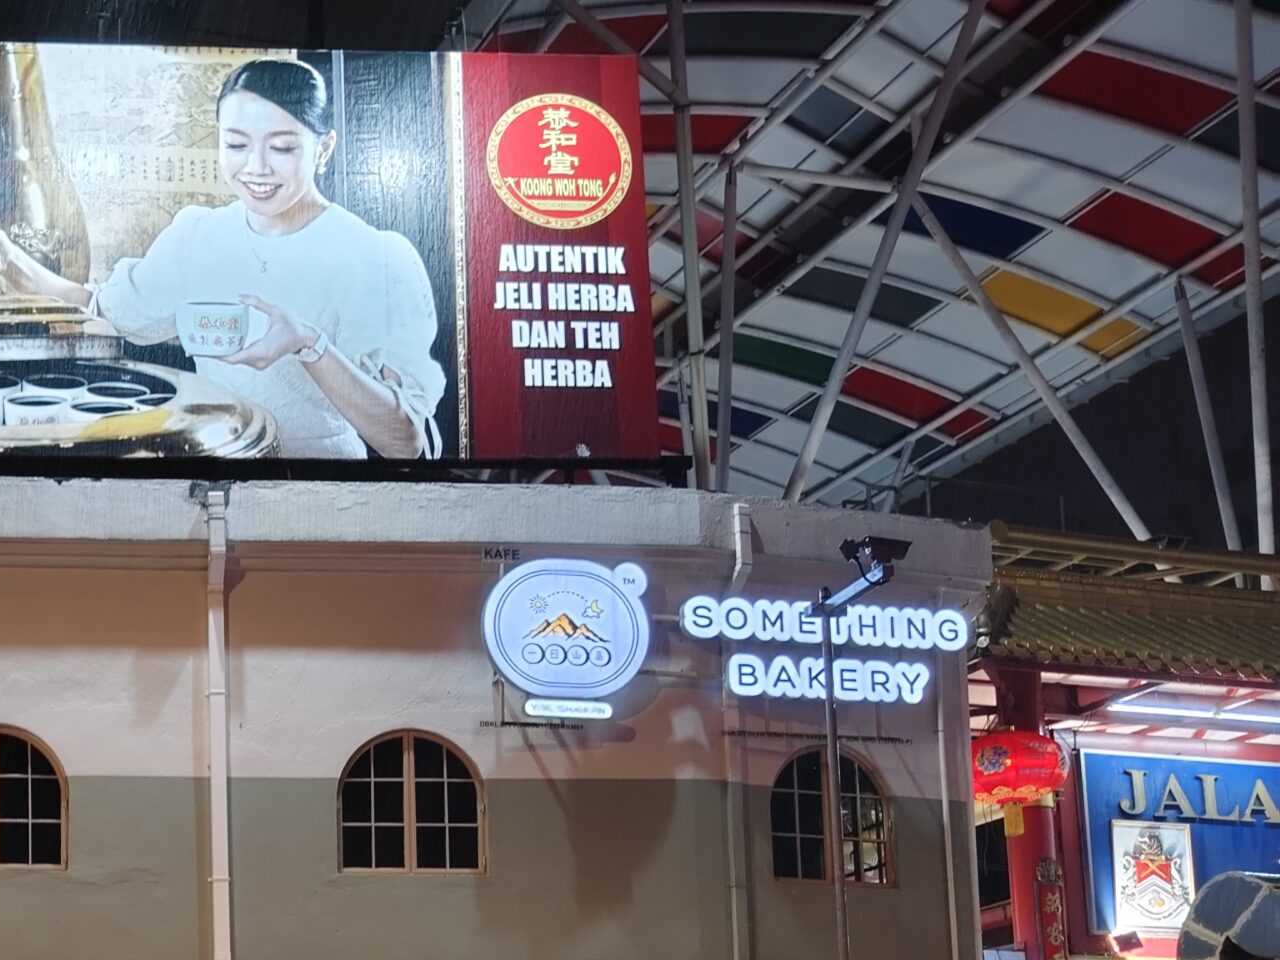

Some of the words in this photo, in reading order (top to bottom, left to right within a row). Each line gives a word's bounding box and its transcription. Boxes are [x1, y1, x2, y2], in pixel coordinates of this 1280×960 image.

[538, 107, 578, 175] 恭和堂
[520, 177, 554, 197] KOONG
[555, 177, 577, 197] WOH
[578, 178, 604, 198] TONG
[499, 244, 626, 275] AUTENTIK
[494, 282, 542, 311] JELI
[547, 283, 635, 313] HERBA
[511, 321, 566, 349] DAN
[571, 321, 620, 350] TEH
[524, 359, 613, 388] HERBA
[484, 548, 520, 560] KAFE
[622, 577, 636, 585] TM
[738, 663, 922, 695] BAKERY
